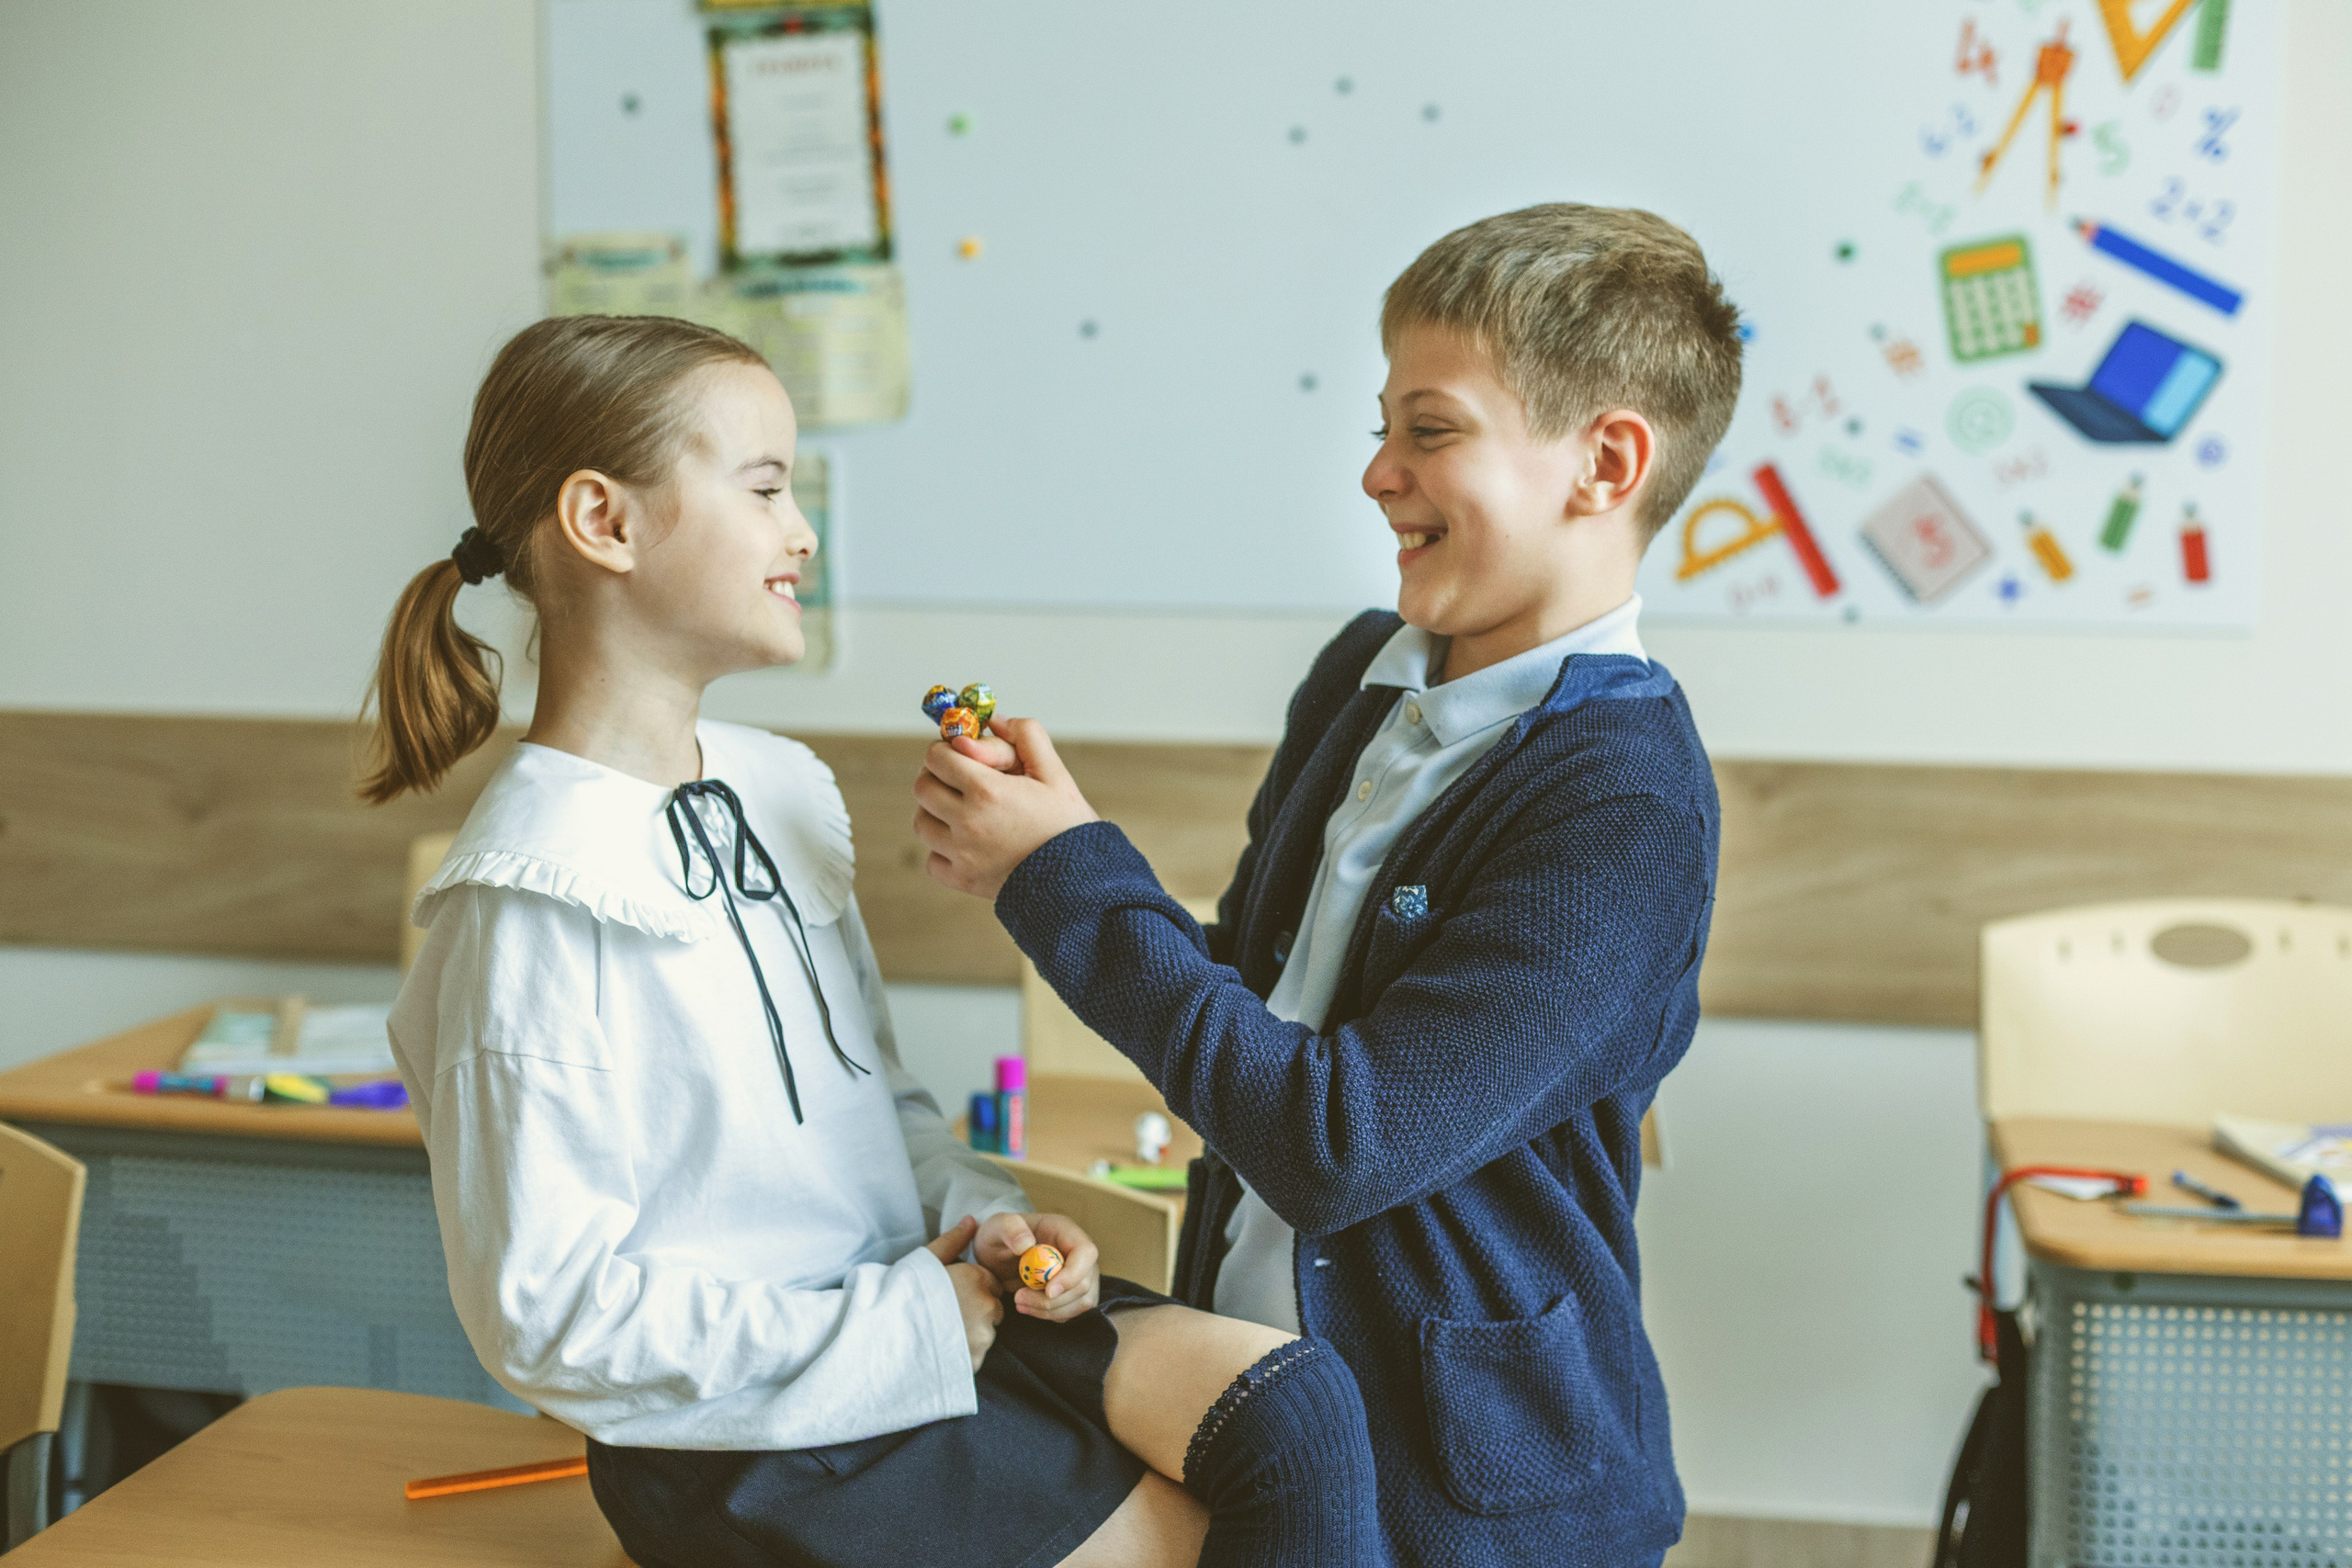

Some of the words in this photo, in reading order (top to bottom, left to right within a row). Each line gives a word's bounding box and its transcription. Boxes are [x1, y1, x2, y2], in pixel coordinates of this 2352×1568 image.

[1955, 17, 1999, 88] 4
[2092, 119, 2131, 176] 5
[1912, 513, 1955, 570] 5
